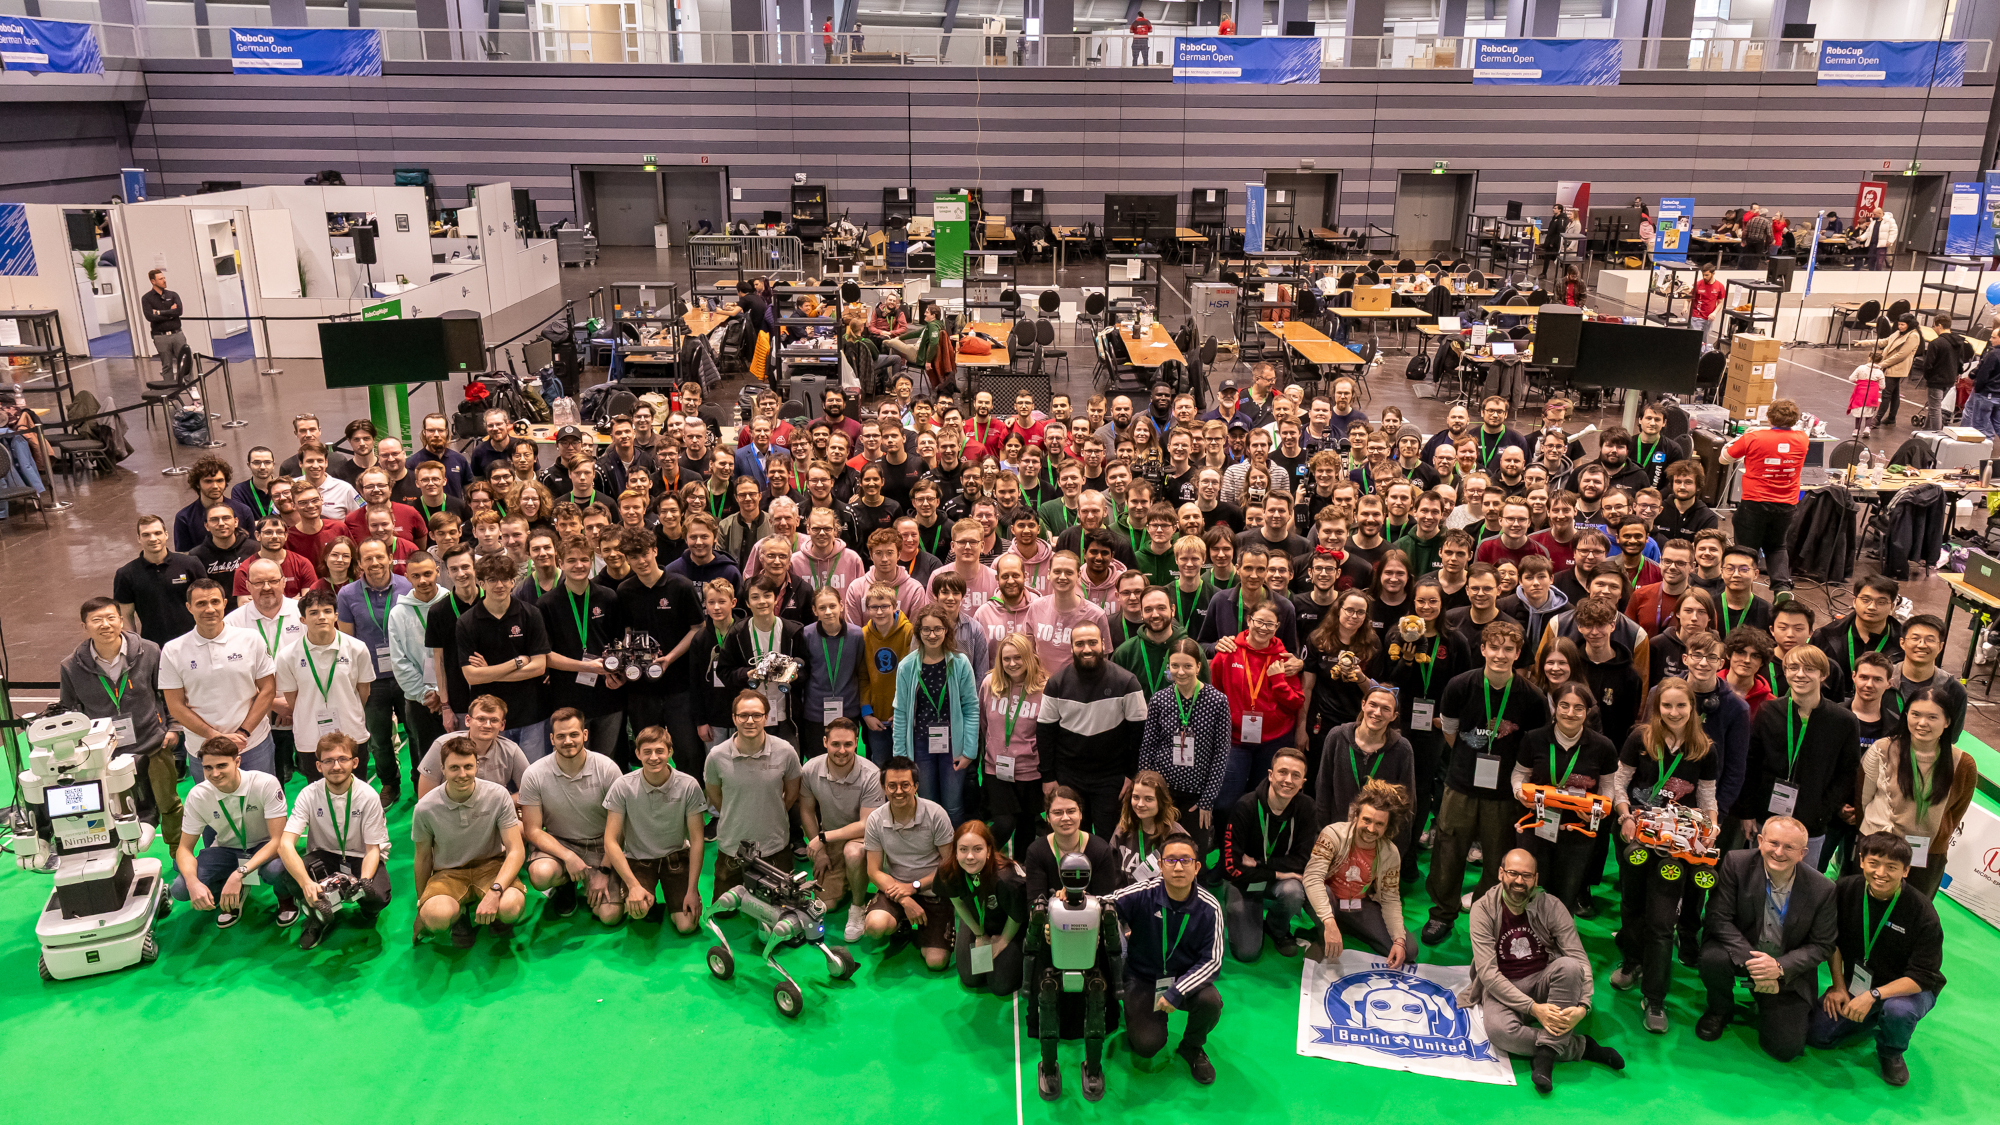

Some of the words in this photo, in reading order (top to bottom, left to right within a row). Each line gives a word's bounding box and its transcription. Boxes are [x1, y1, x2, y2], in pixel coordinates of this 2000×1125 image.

[0, 23, 24, 35] oboCup
[24, 35, 40, 46] Open
[235, 34, 274, 44] RoboCup
[236, 44, 269, 52] German
[271, 45, 293, 54] Open
[1179, 43, 1217, 53] RoboCup
[1481, 44, 1518, 54] RoboCup
[1826, 46, 1863, 57] RoboCup
[1179, 53, 1211, 61] German
[1212, 53, 1234, 63] Open
[1480, 54, 1511, 63] German
[1513, 55, 1534, 64] Open
[1825, 56, 1856, 65] German
[1857, 57, 1879, 66] Open
[1209, 300, 1231, 309] HSR
[228, 653, 243, 661] SOS
[64, 833, 108, 847] NimbRo
[1338, 1028, 1390, 1045] Berlin
[1413, 1037, 1467, 1054] United
